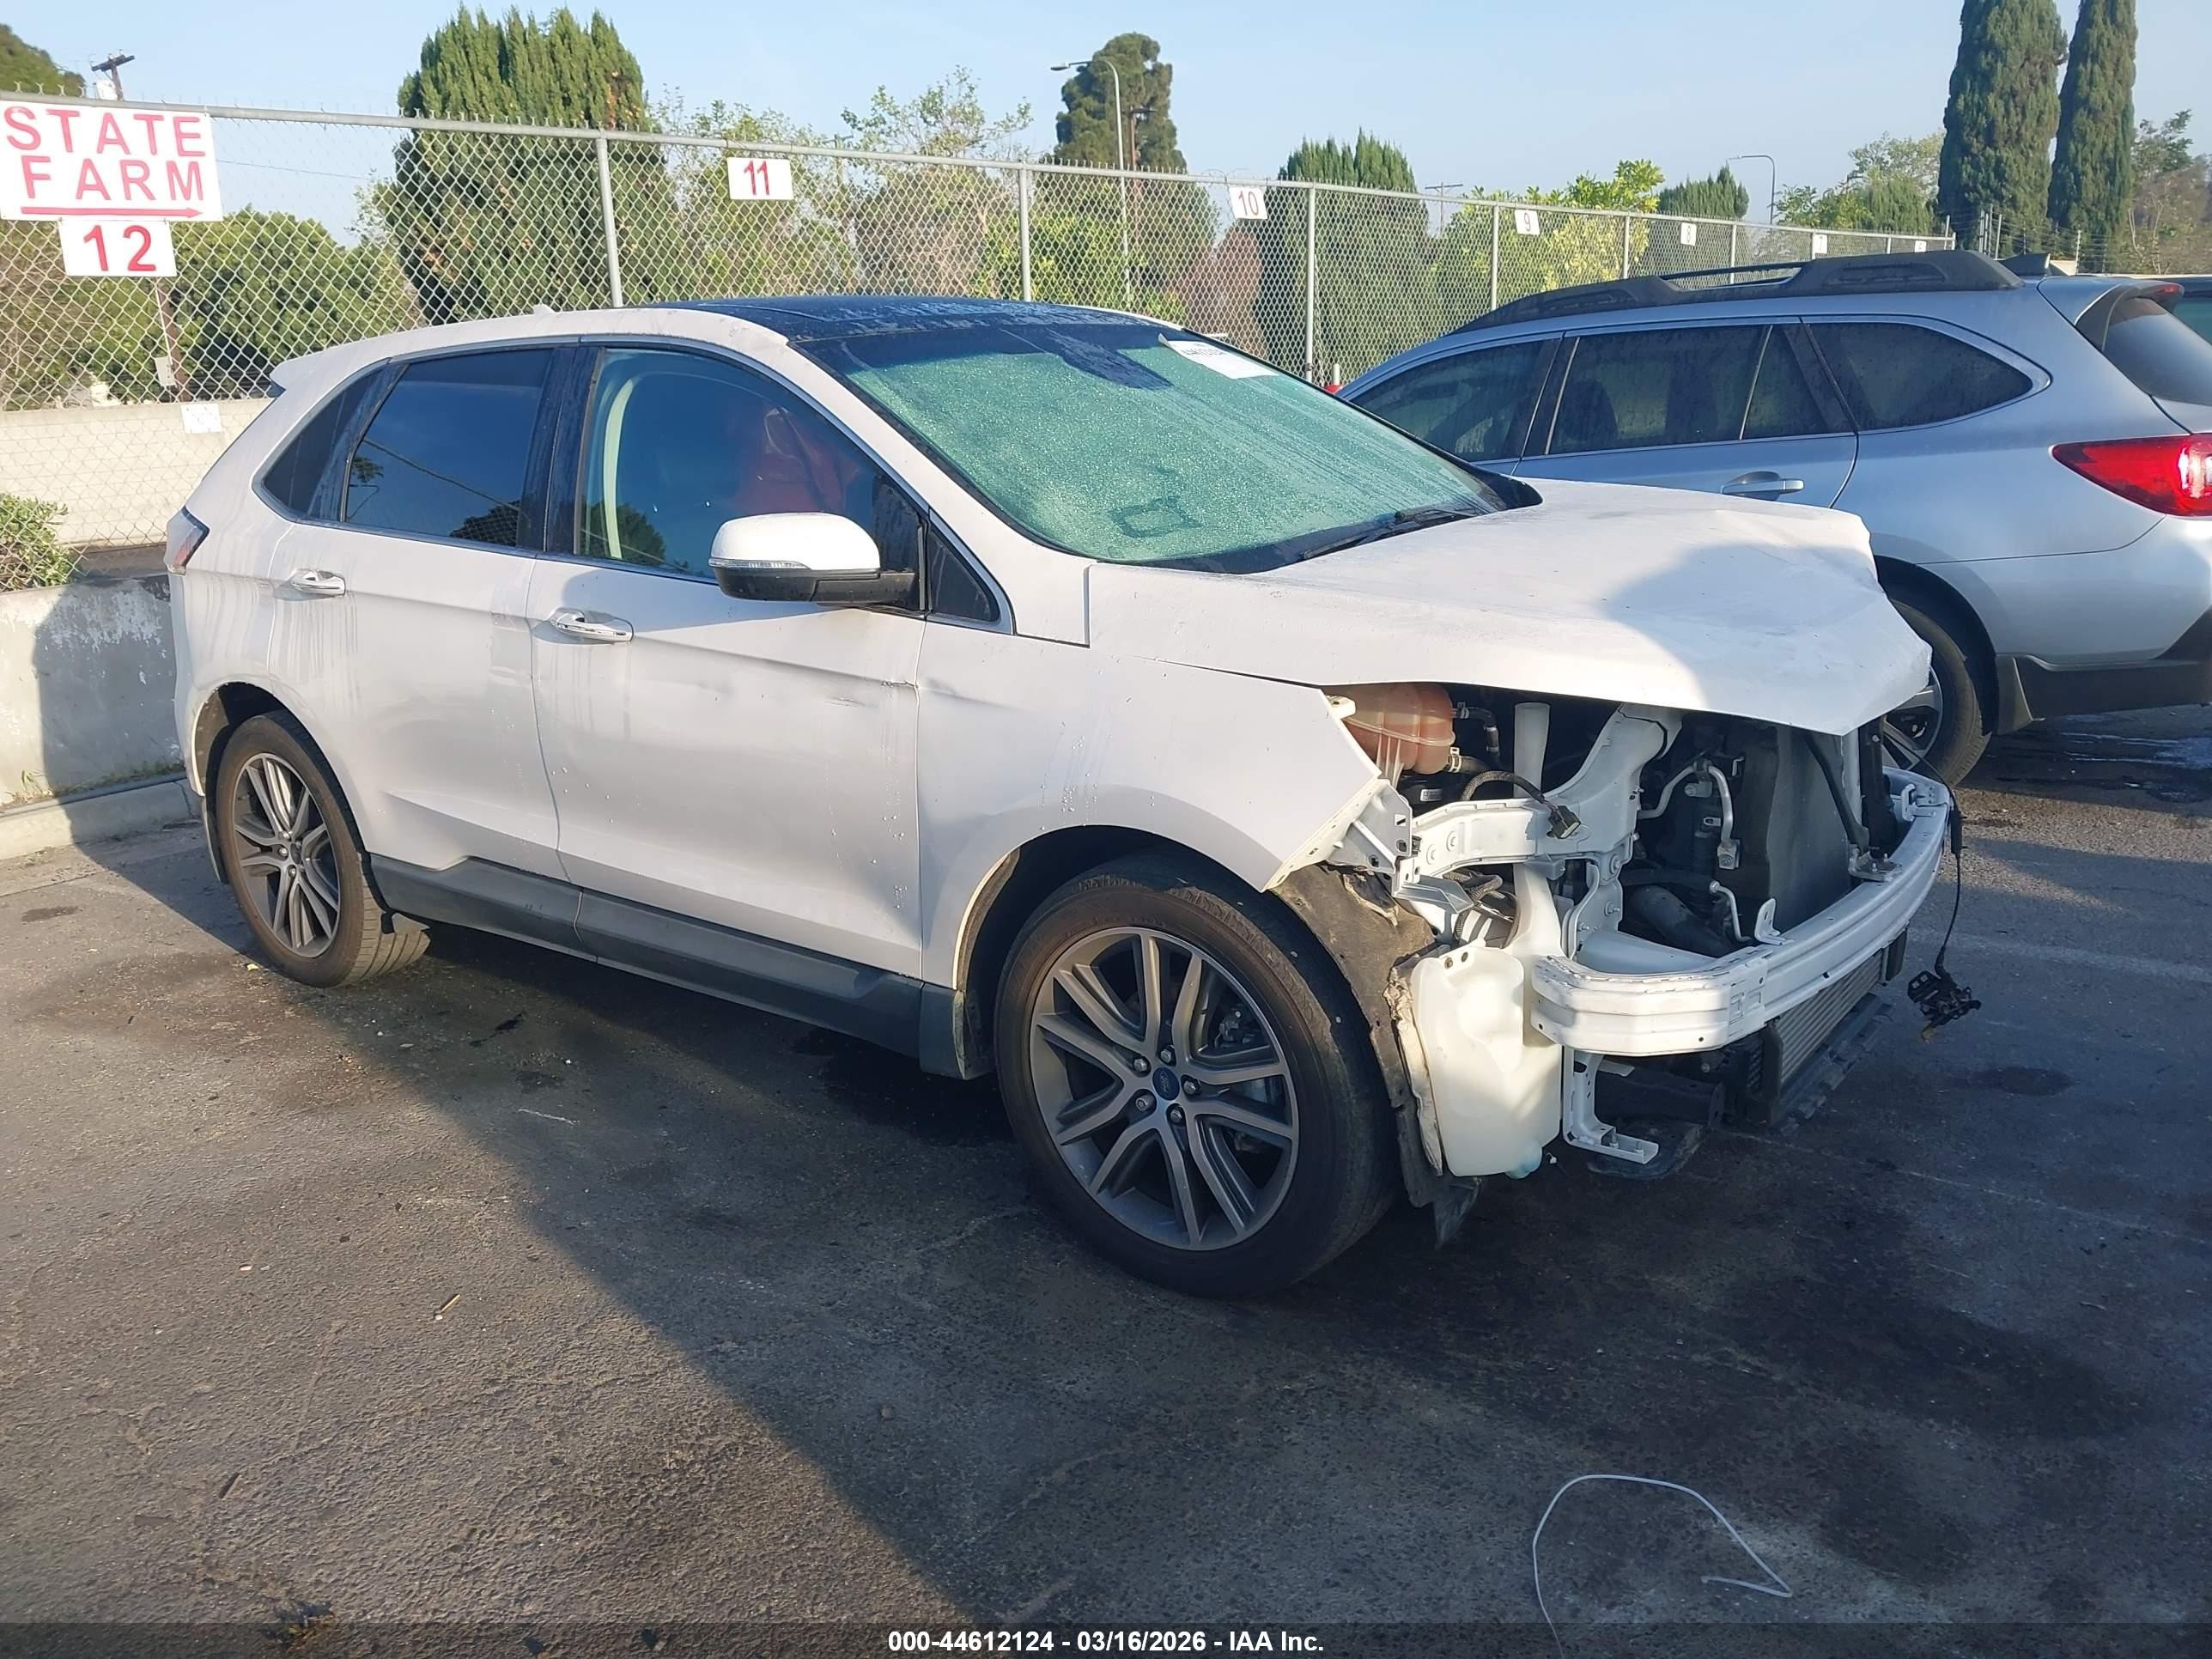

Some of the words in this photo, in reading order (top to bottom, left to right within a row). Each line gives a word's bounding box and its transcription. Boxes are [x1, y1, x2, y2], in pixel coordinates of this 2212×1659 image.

[3, 106, 206, 157] STATE
[21, 155, 204, 200] FARM
[743, 160, 770, 196] 11
[1238, 190, 1259, 216] 10
[1523, 211, 1531, 232] 9
[82, 224, 157, 272] 12
